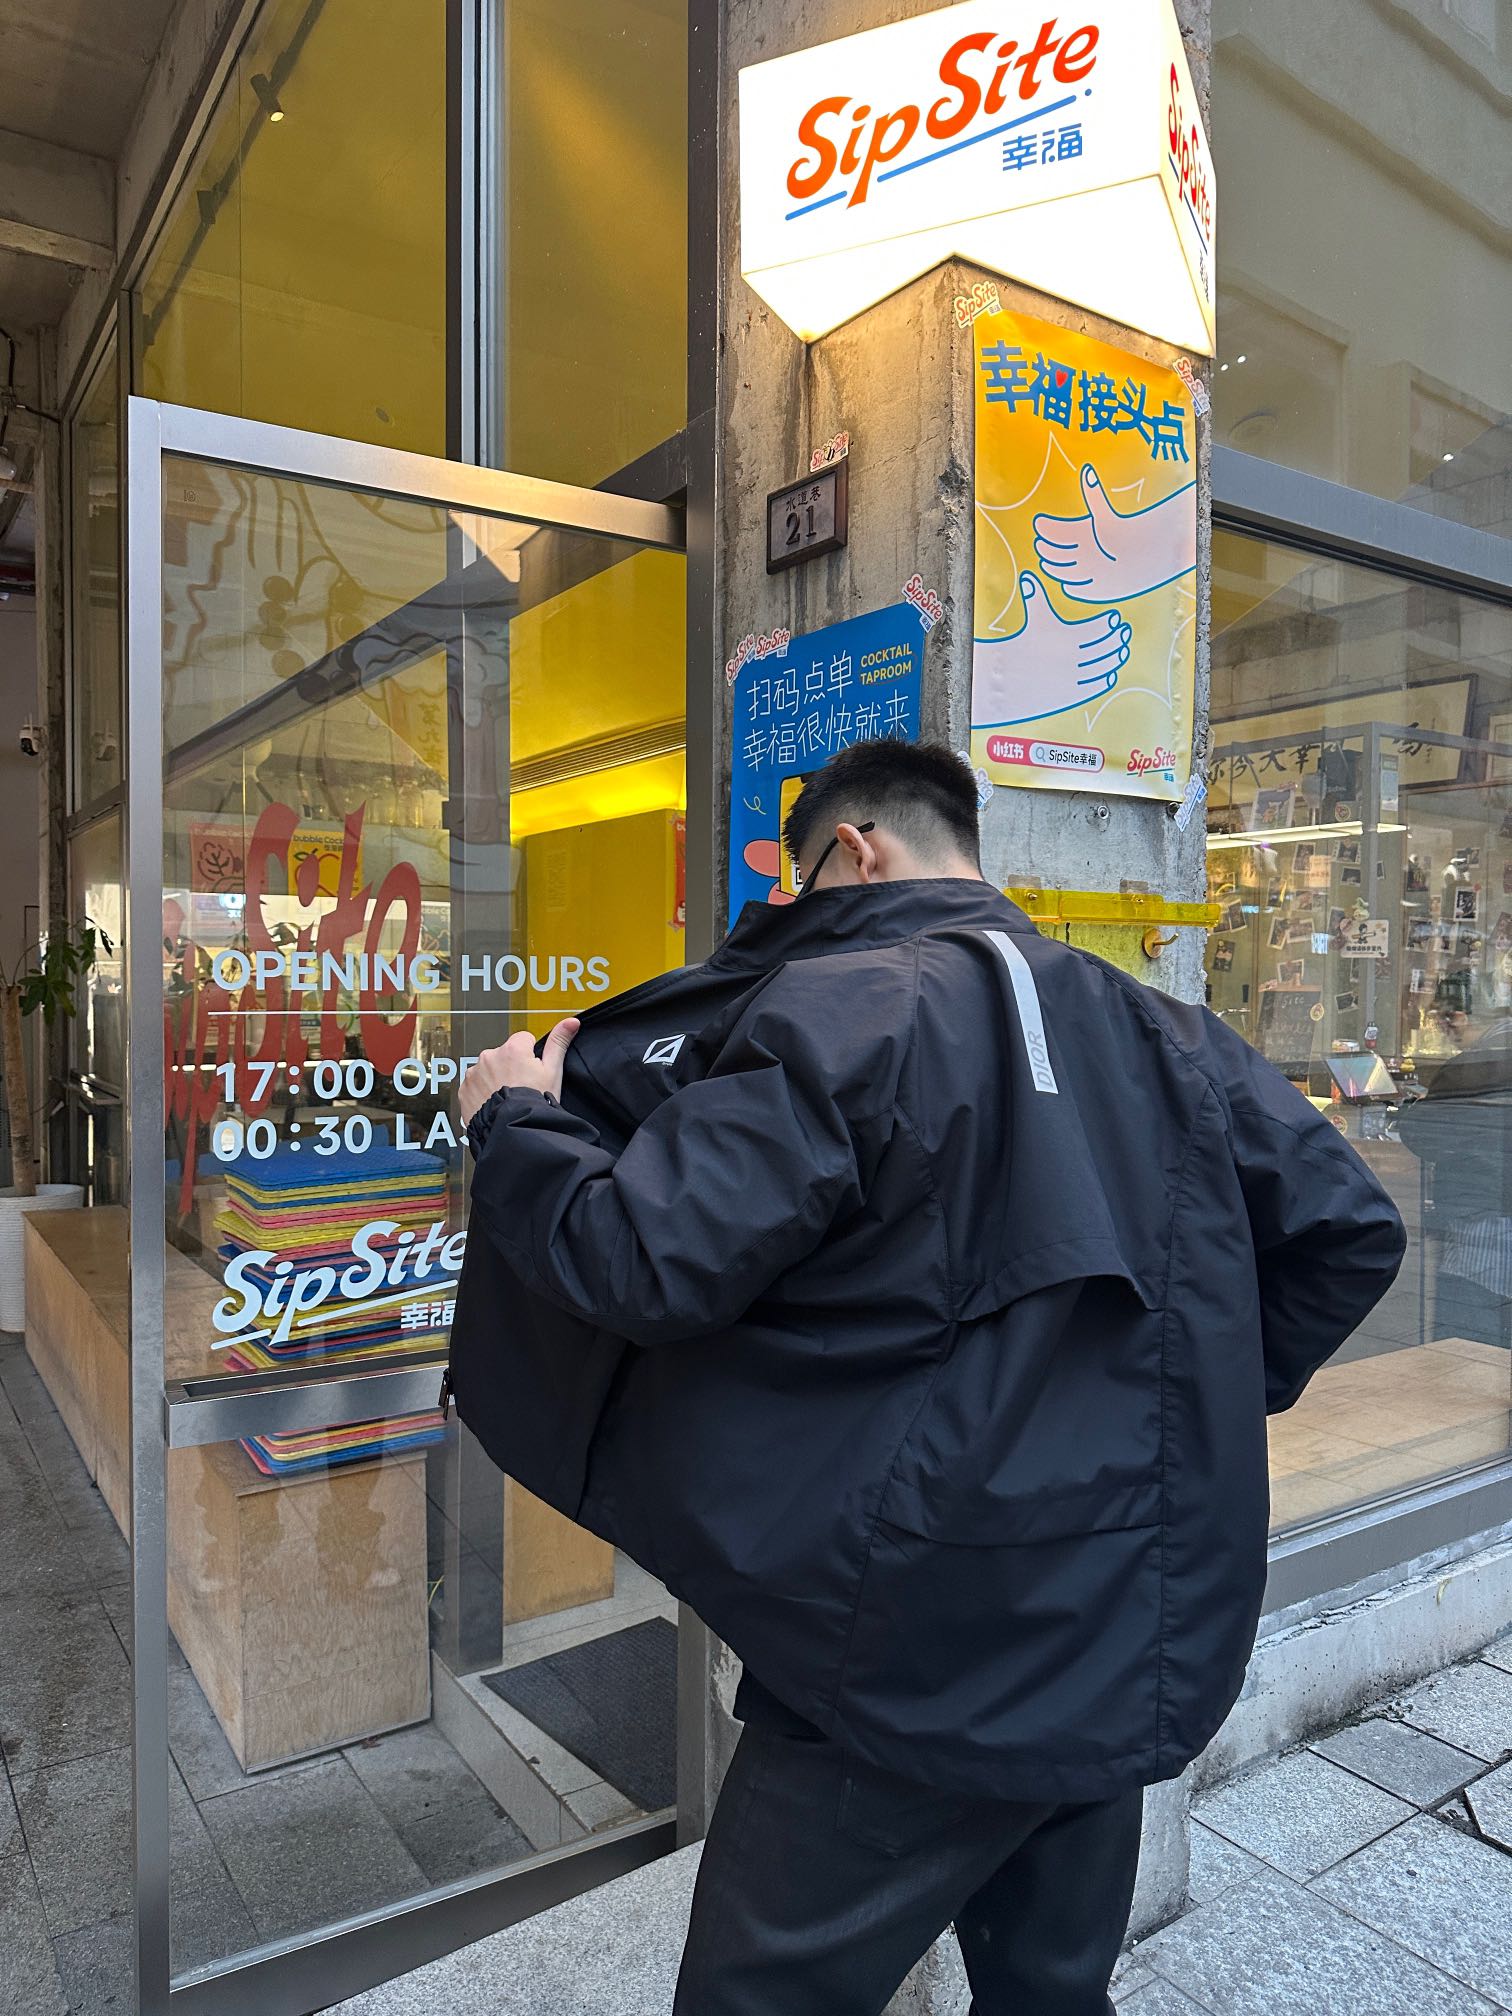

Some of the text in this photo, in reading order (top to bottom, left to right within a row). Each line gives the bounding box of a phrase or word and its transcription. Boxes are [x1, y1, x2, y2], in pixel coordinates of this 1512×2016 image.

[786, 18, 1100, 209] SipSite
[1002, 123, 1083, 171] 幸福
[980, 340, 1189, 463] 幸福接头点
[786, 486, 821, 511] 水道巷
[786, 505, 817, 545] 21
[906, 576, 942, 620] SipSite
[756, 630, 790, 656] SipSite
[860, 643, 912, 668] COCKTAIL
[746, 650, 853, 722] 扫码点单
[860, 660, 912, 685] TAPROOM
[743, 689, 910, 772] 幸福很快就来
[993, 741, 1024, 759] 小红书
[1127, 746, 1176, 777] SipSite
[211, 949, 610, 993] OPENING HOURS
[215, 1058, 376, 1103] 17:00
[1027, 1030, 1054, 1088] DIOR
[212, 1110, 470, 1162] 00:30 LA
[211, 1220, 468, 1347] SipSite
[400, 1299, 457, 1330] 幸福
